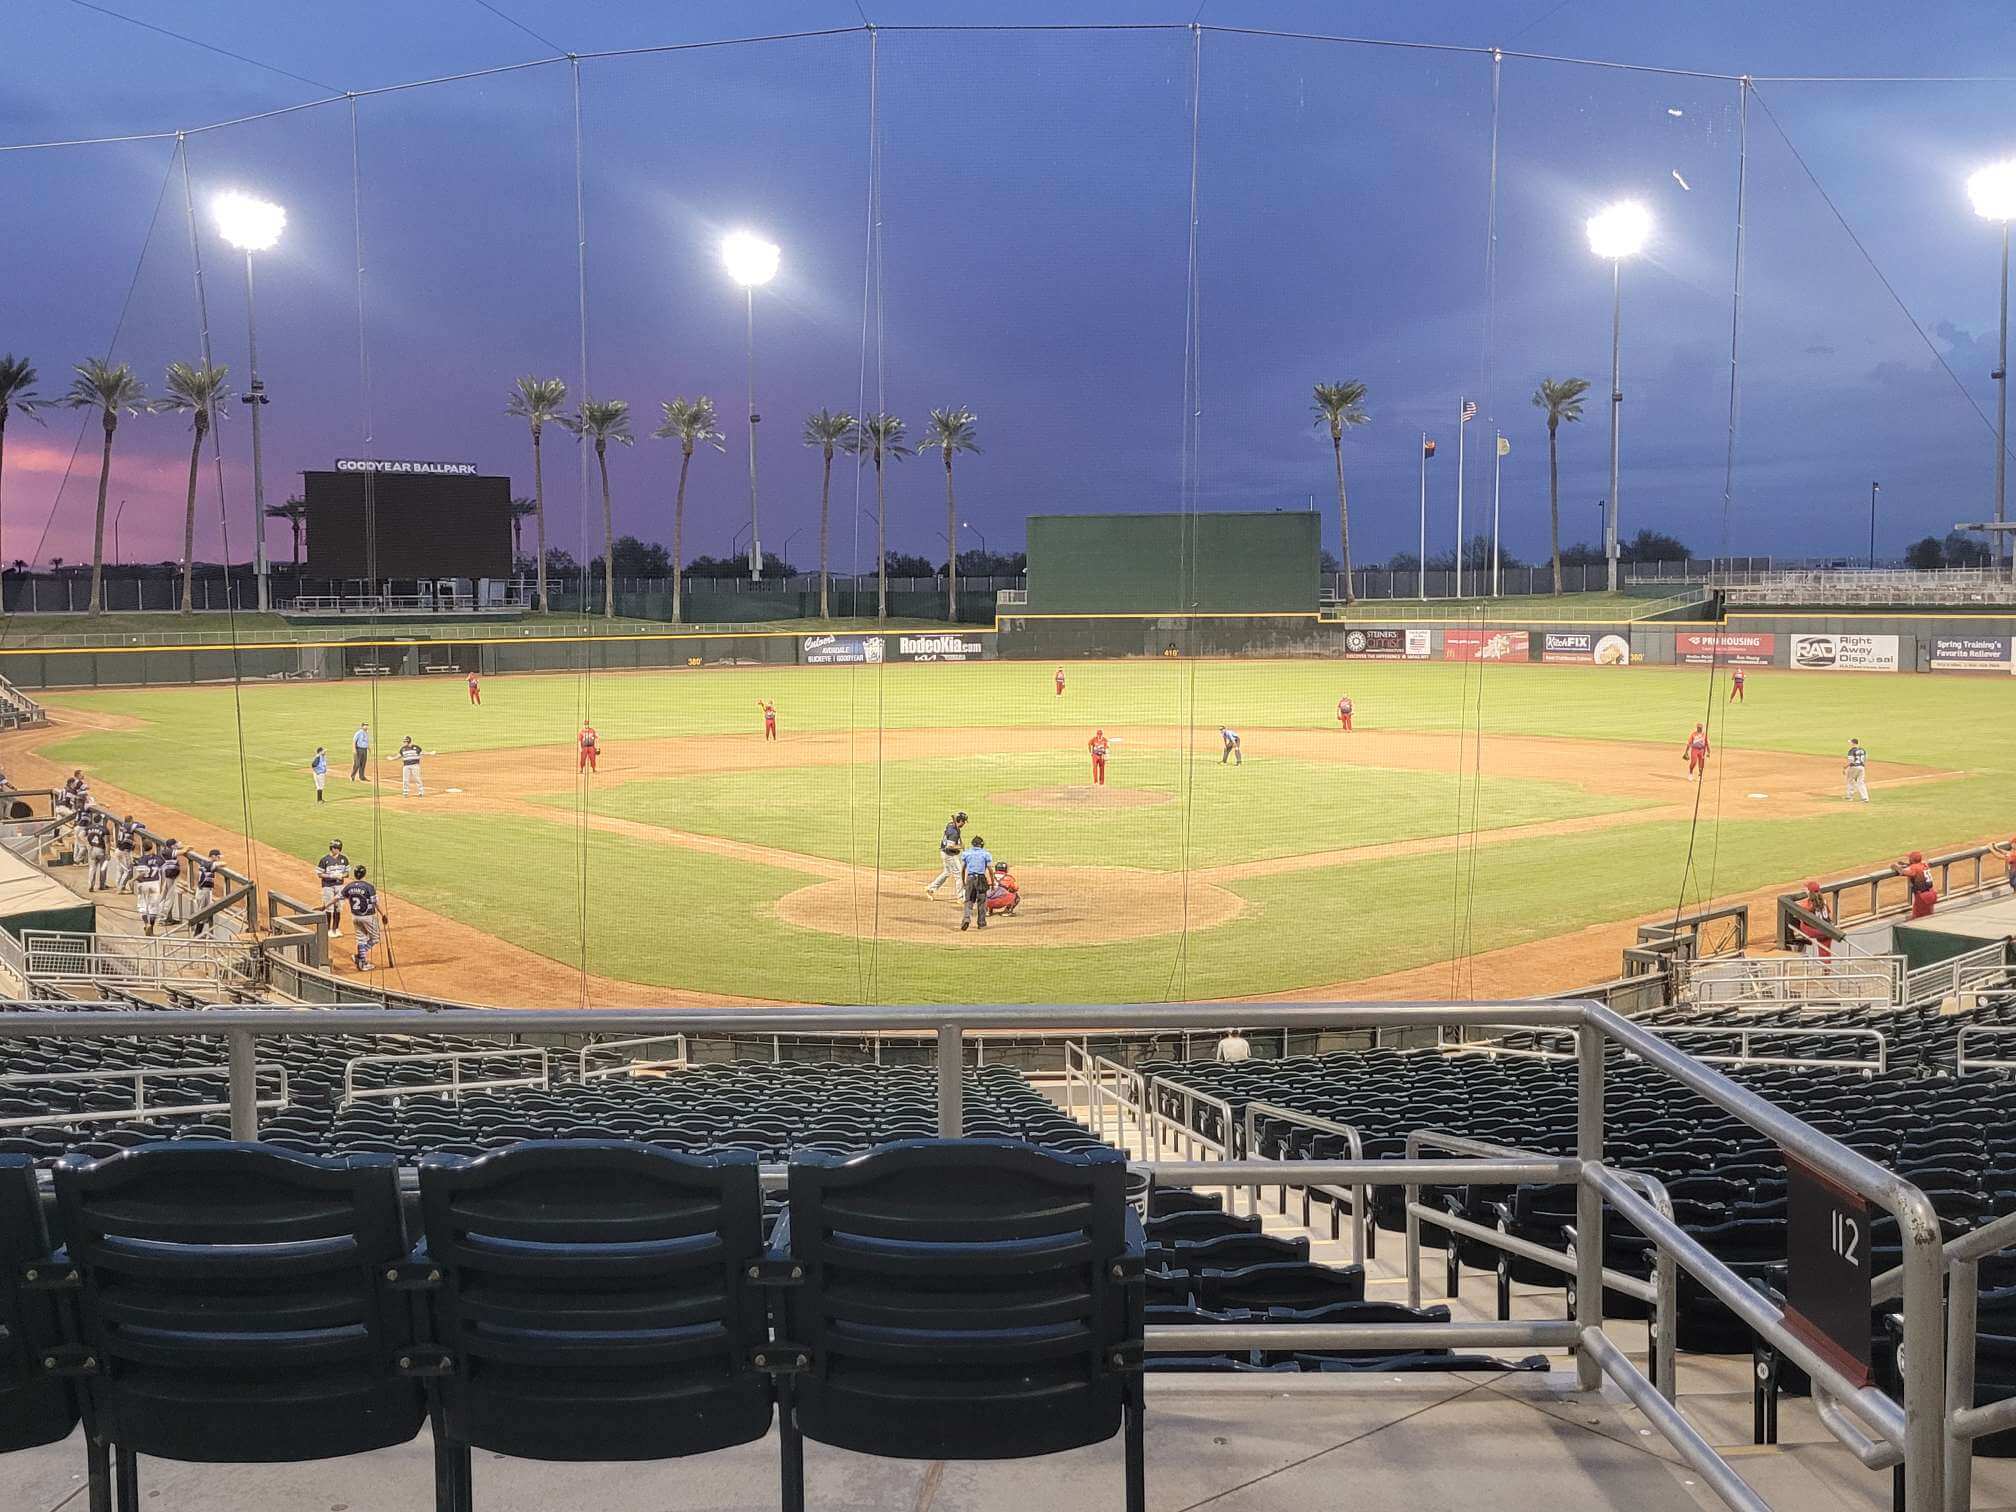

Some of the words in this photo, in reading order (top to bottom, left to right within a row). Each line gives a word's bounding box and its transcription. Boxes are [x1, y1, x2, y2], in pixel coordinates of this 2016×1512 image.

[337, 460, 411, 472] GOODYEAR
[413, 462, 476, 474] BALLPARK
[900, 637, 982, 654] RodeoKia.com
[1721, 638, 1760, 646] HOUSING
[1840, 637, 1872, 646] Right
[1937, 640, 1962, 649] Spring
[1963, 641, 2001, 649] Training's
[1840, 646, 1872, 655] Away
[352, 897, 361, 910] 2
[1832, 1208, 1859, 1267] 112
